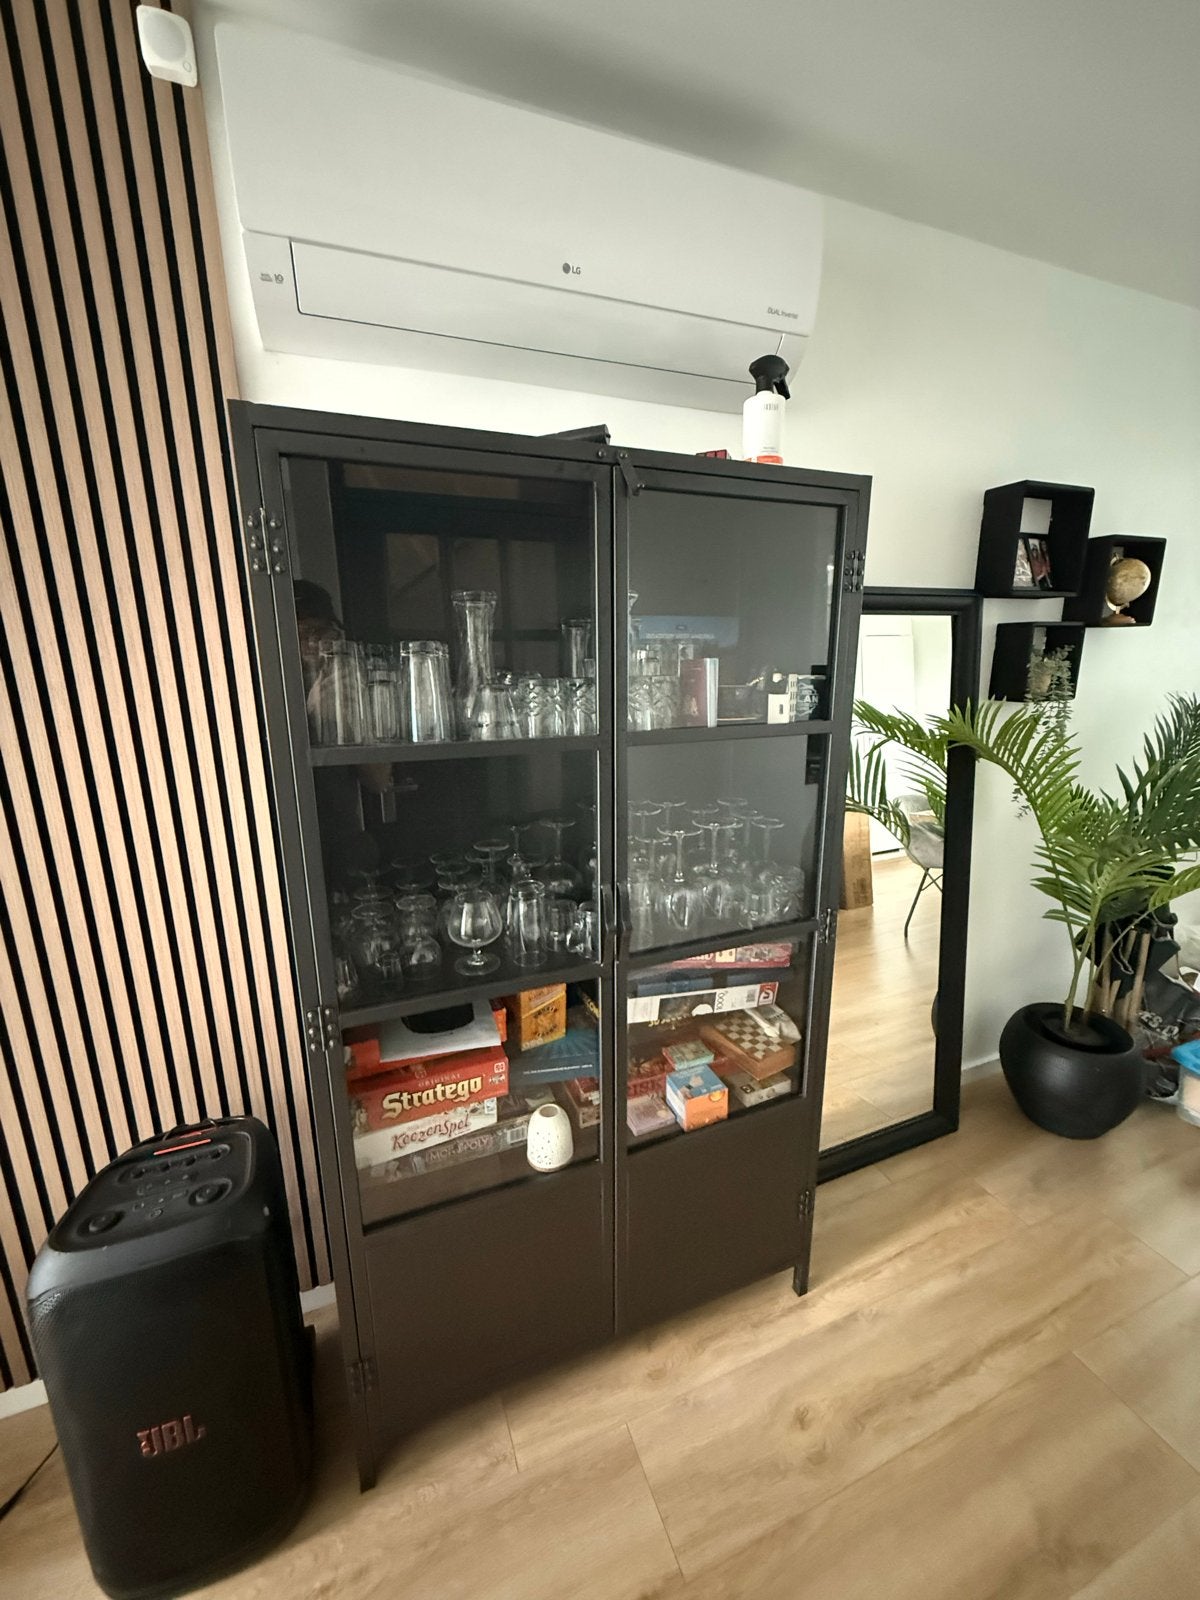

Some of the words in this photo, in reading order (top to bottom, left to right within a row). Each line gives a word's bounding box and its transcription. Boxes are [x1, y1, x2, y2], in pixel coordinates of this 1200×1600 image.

[571, 265, 581, 275] LG
[382, 1076, 482, 1119] Stratego
[137, 1414, 208, 1457] JBL
